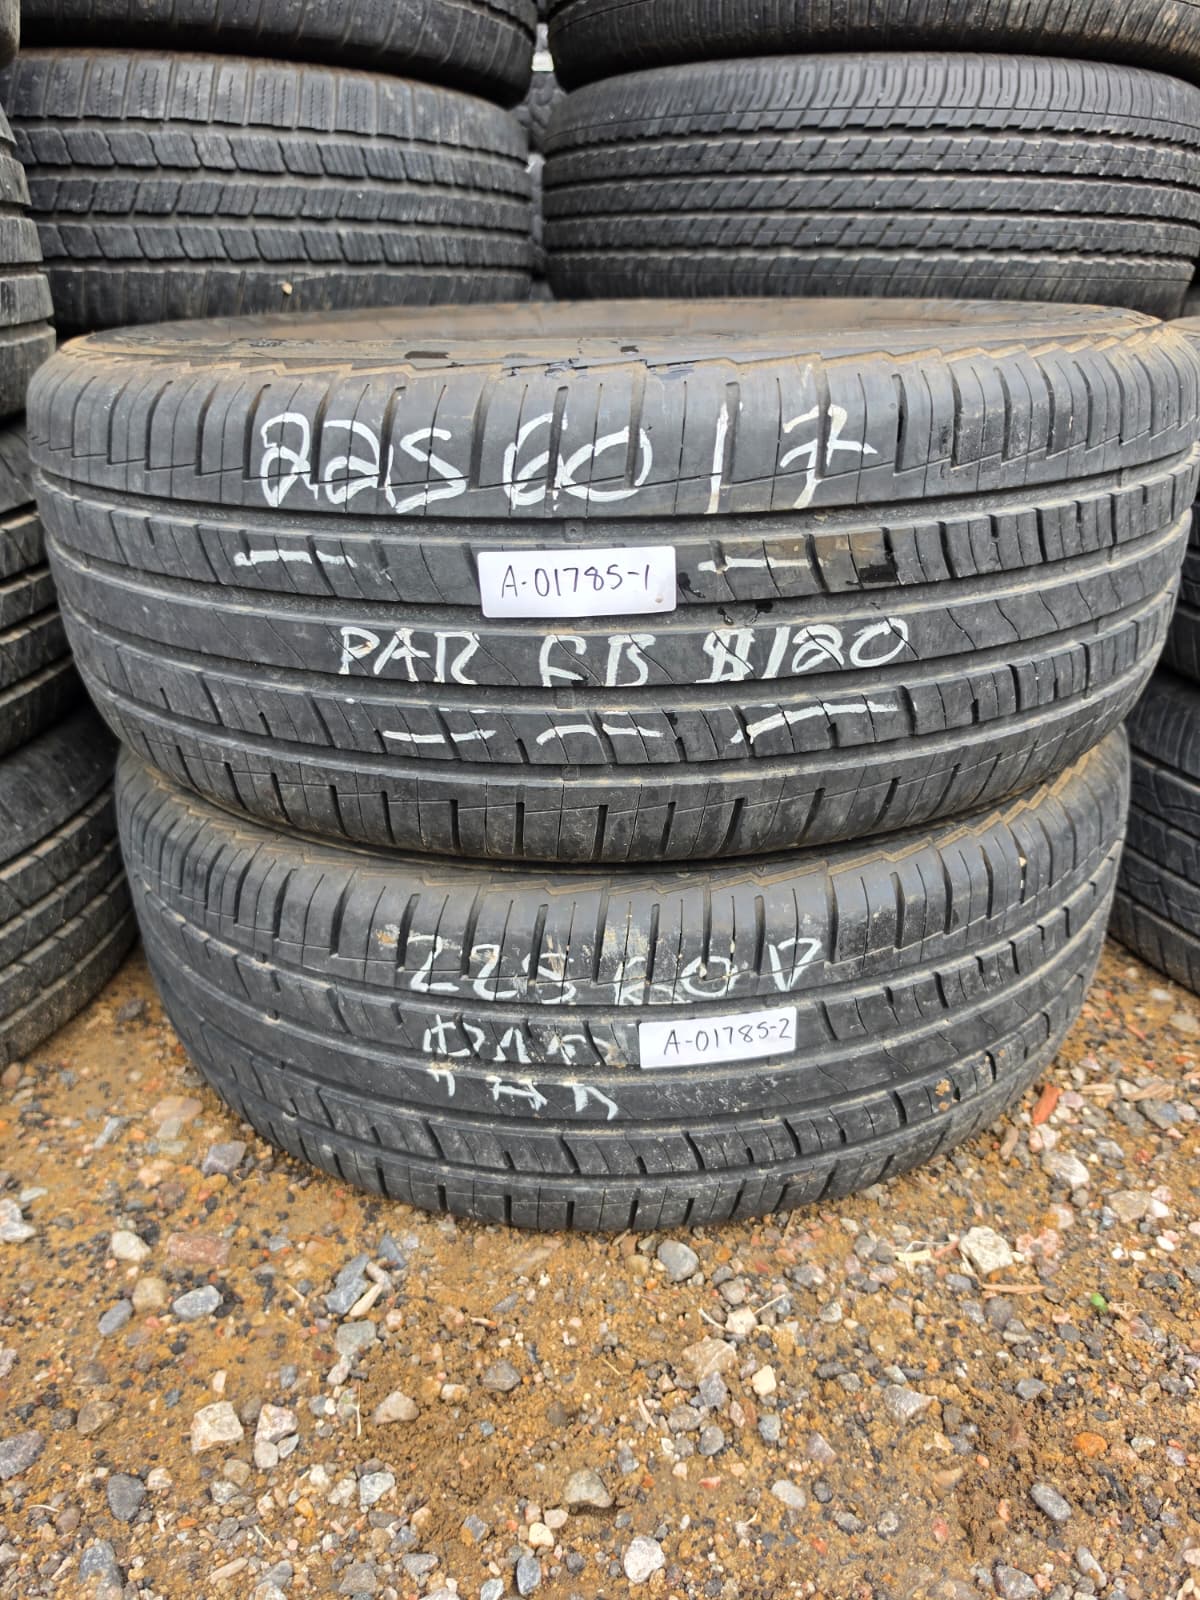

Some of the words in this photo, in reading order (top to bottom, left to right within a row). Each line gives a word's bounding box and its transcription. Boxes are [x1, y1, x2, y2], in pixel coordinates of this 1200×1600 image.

[260, 412, 467, 513] 225
[502, 412, 653, 511] 60
[501, 563, 651, 599] A-01785-1
[406, 934, 577, 1006] 225
